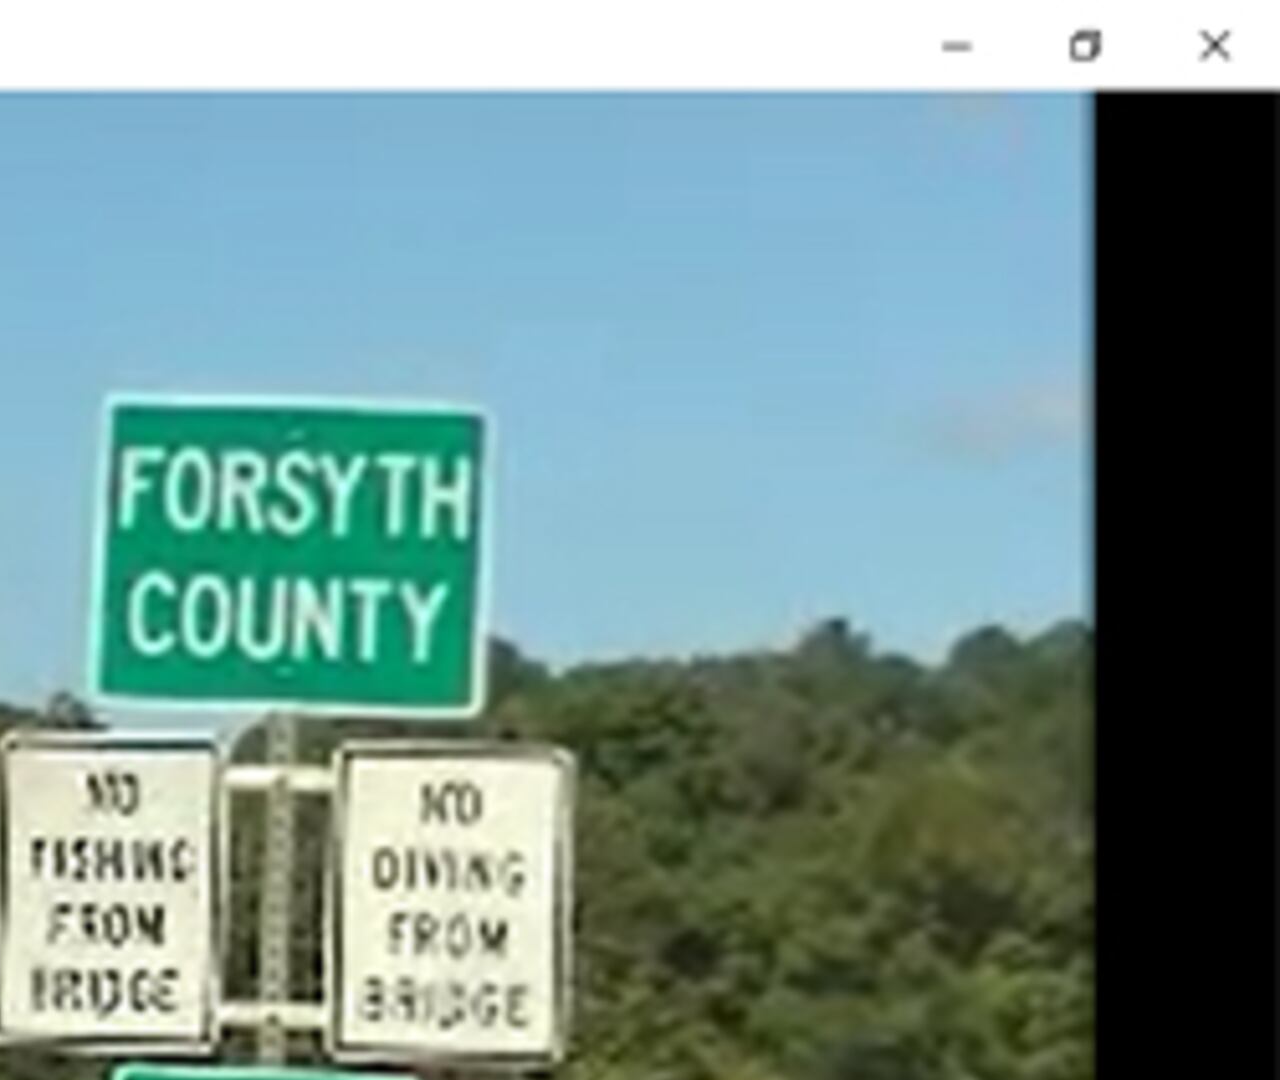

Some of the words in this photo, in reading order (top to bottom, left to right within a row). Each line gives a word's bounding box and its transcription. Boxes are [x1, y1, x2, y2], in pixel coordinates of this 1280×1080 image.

[115, 444, 471, 542] FORSYTH
[127, 570, 450, 664] COUNTY
[85, 772, 141, 817] NO
[419, 780, 483, 825] NO
[371, 846, 526, 898] DIVING
[45, 902, 166, 948] FROM
[387, 911, 509, 960] FROM
